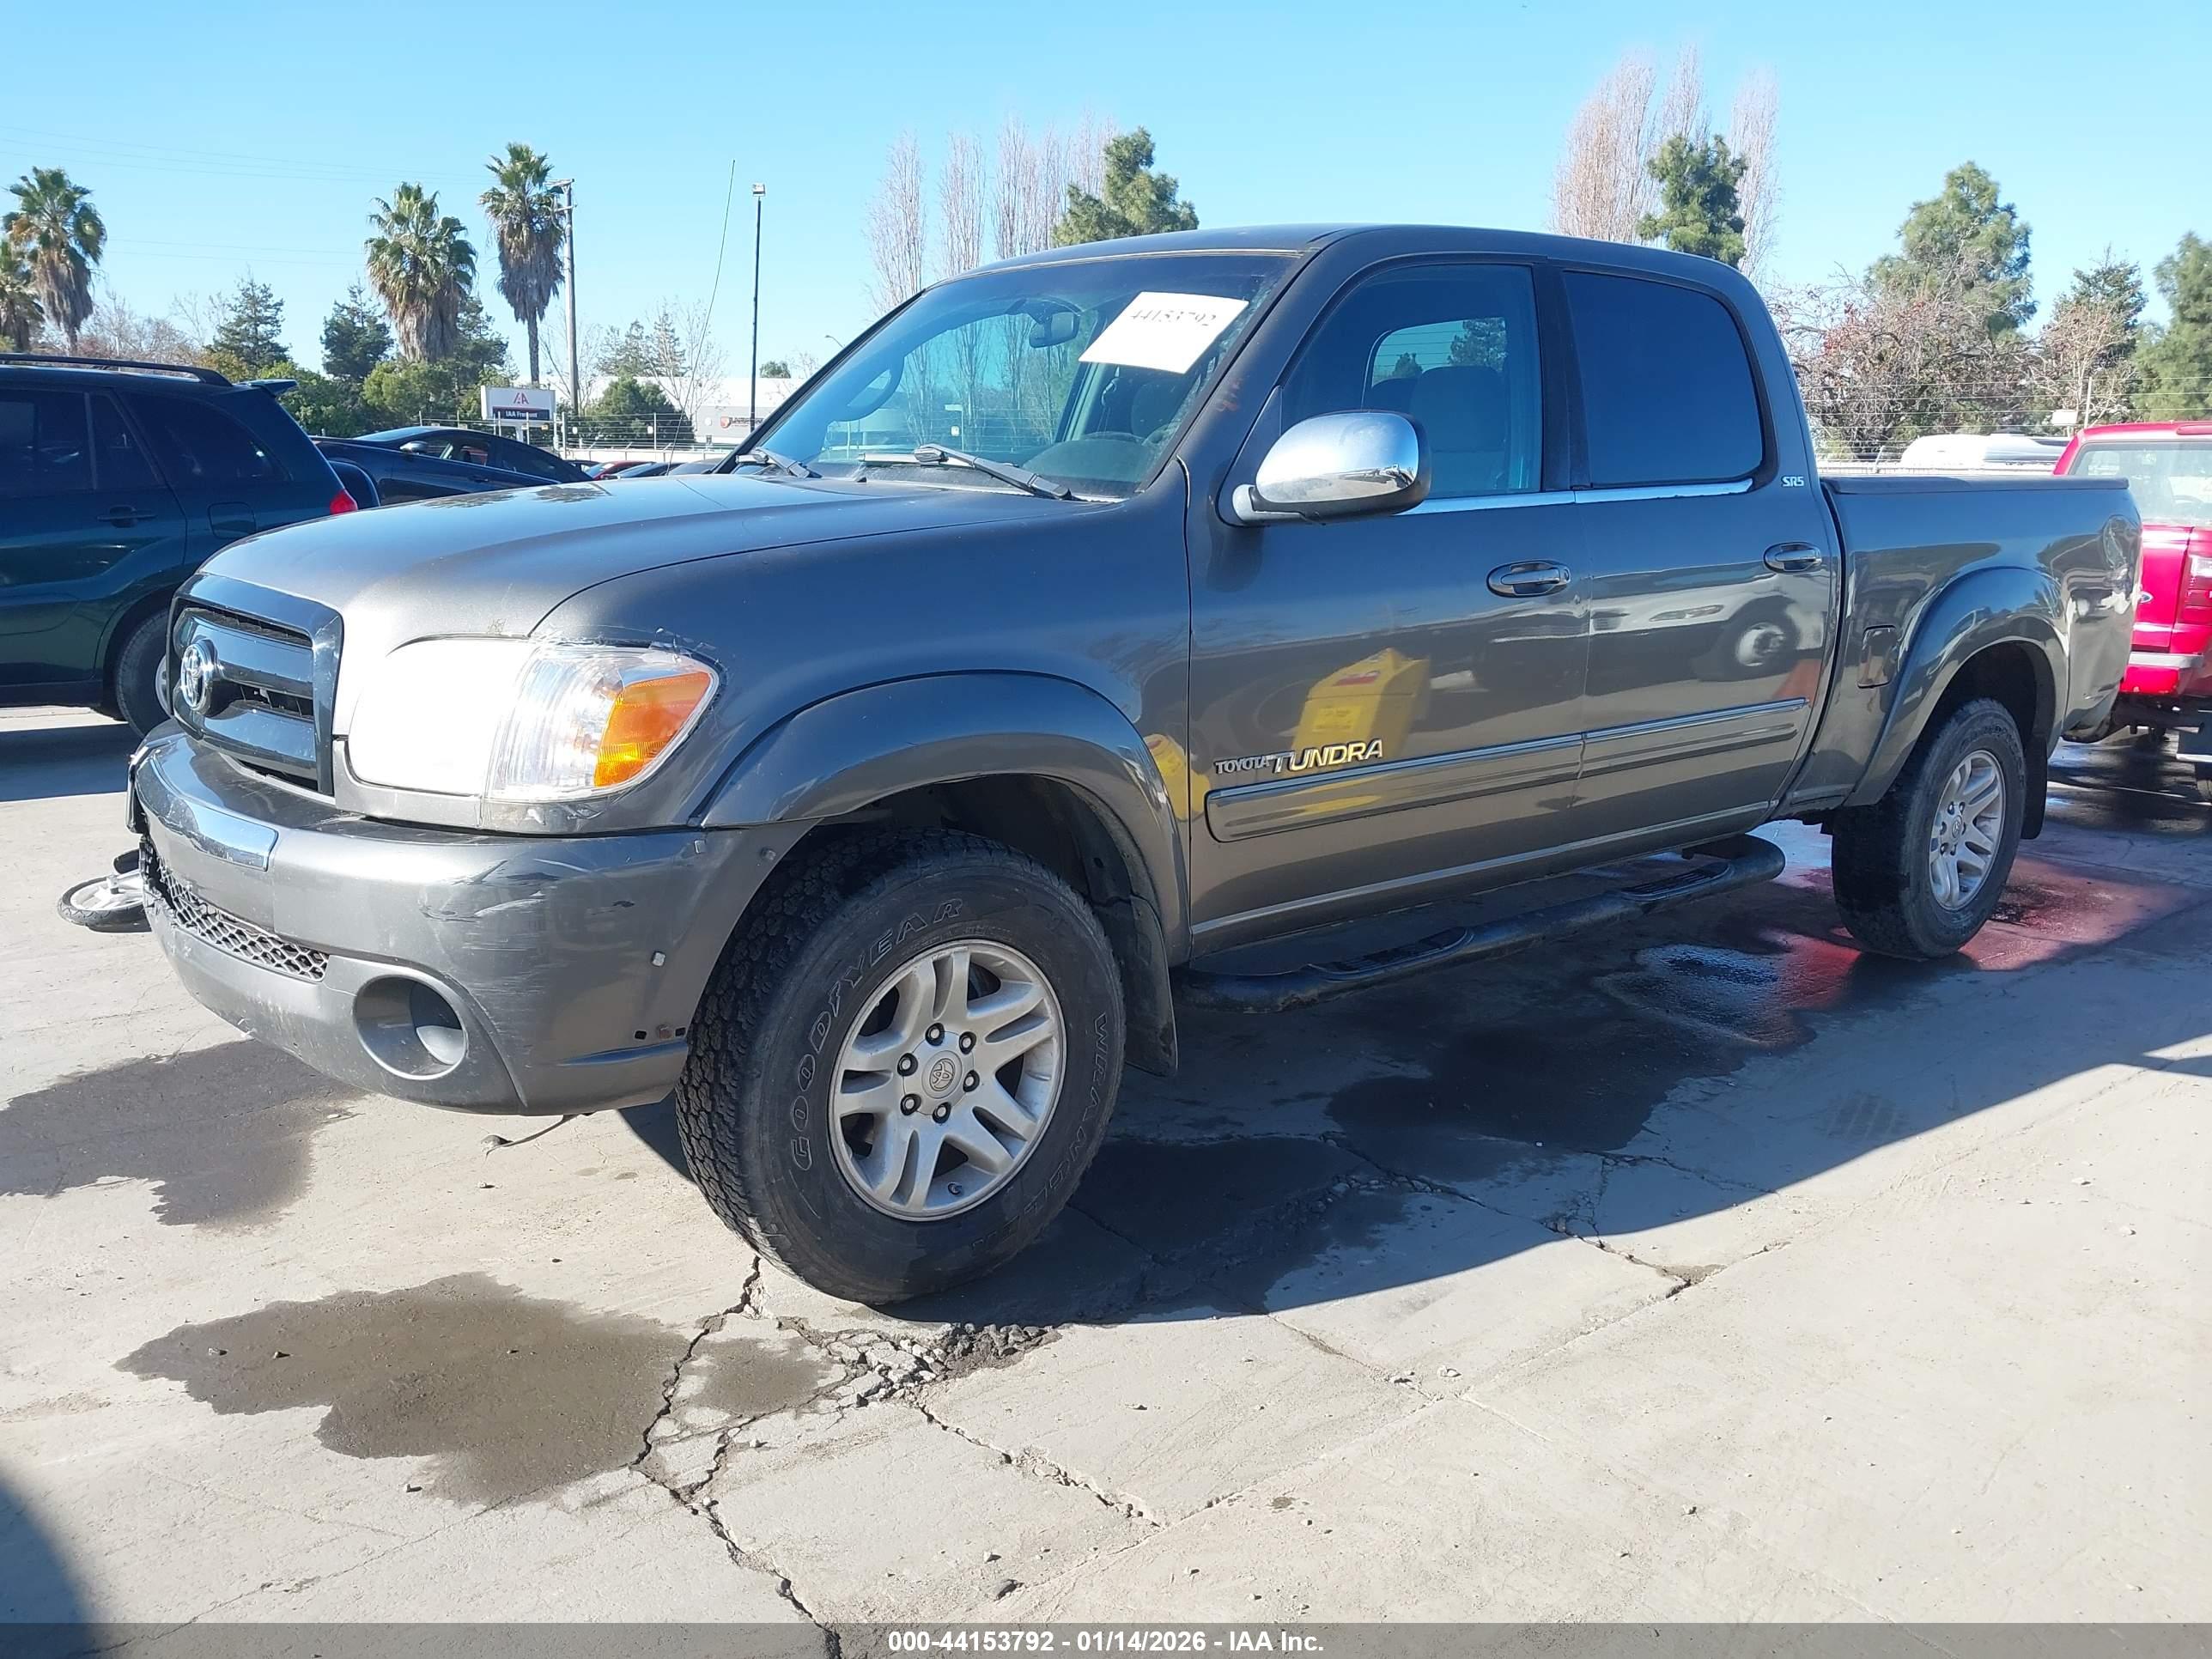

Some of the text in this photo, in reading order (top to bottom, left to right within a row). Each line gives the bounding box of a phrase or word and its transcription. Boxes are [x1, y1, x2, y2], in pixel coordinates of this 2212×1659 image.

[1781, 476, 1805, 487] SR5
[1214, 738, 1383, 774] TOYOTA TUNDRA
[791, 898, 963, 1170] GOODYEAR
